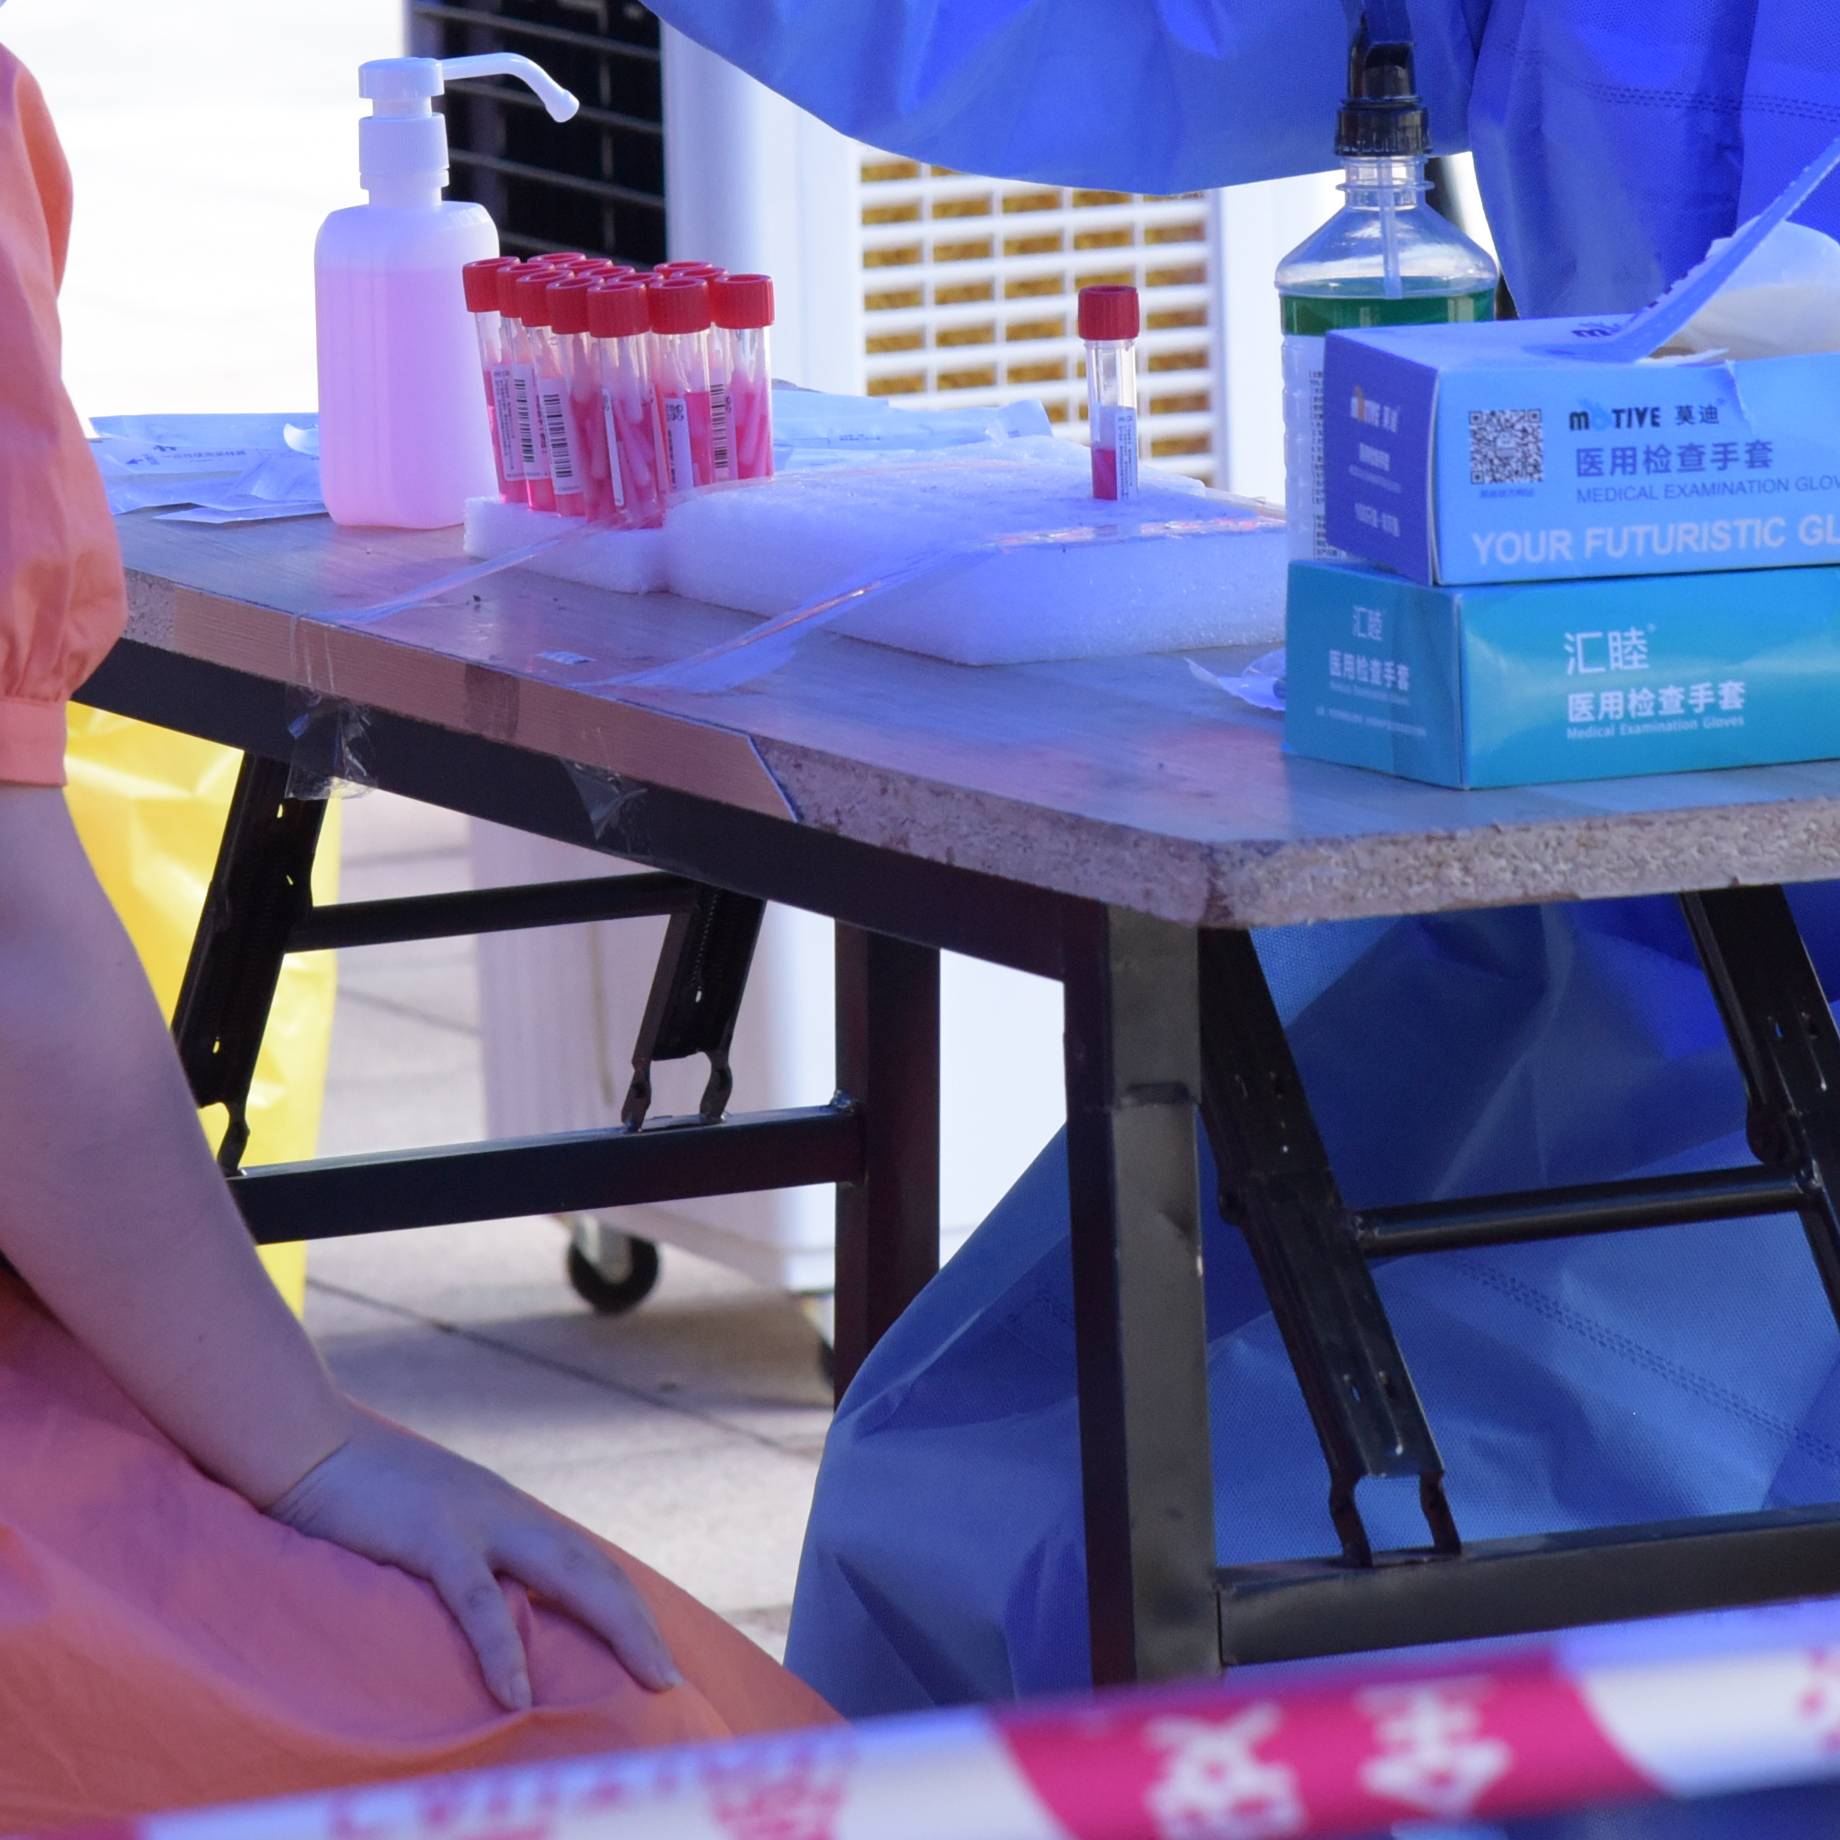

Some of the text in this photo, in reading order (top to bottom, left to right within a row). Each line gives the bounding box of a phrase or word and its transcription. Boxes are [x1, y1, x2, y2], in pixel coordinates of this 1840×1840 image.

[1576, 439, 1774, 478] 医用检查手套
[1577, 484, 1659, 504] MEDICAL
[1664, 477, 1790, 500] EXAMINATION
[1471, 528, 1574, 566] YOUR
[1584, 516, 1787, 560] FUTURISTIC
[1563, 626, 1650, 676] 汇睦
[1567, 680, 1747, 724] 医用检查手套
[1620, 718, 1699, 736] Examination
